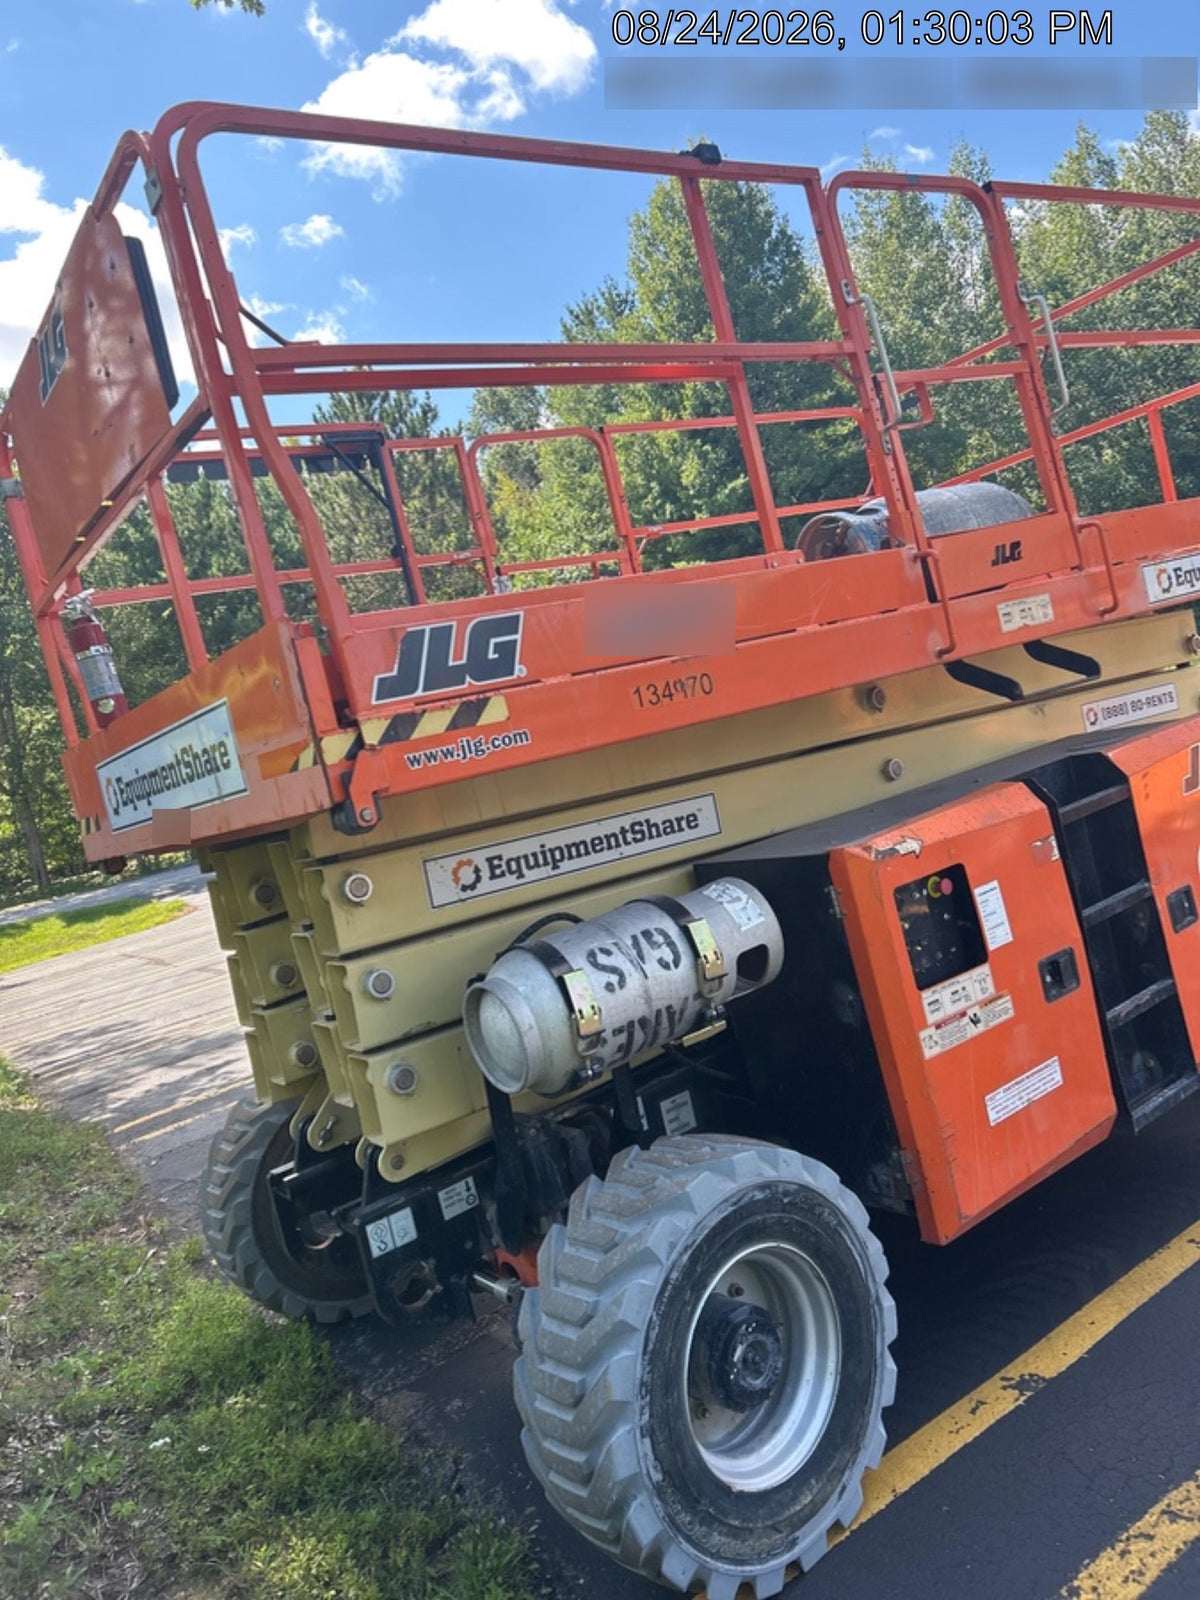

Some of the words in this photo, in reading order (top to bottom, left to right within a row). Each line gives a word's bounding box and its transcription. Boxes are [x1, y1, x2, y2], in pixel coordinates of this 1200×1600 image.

[991, 540, 1024, 568] JLG
[372, 611, 524, 705] JLG
[115, 740, 232, 812] EquipmentShare
[405, 729, 531, 770] www.jlg.com
[485, 811, 700, 881] EquipmentShare
